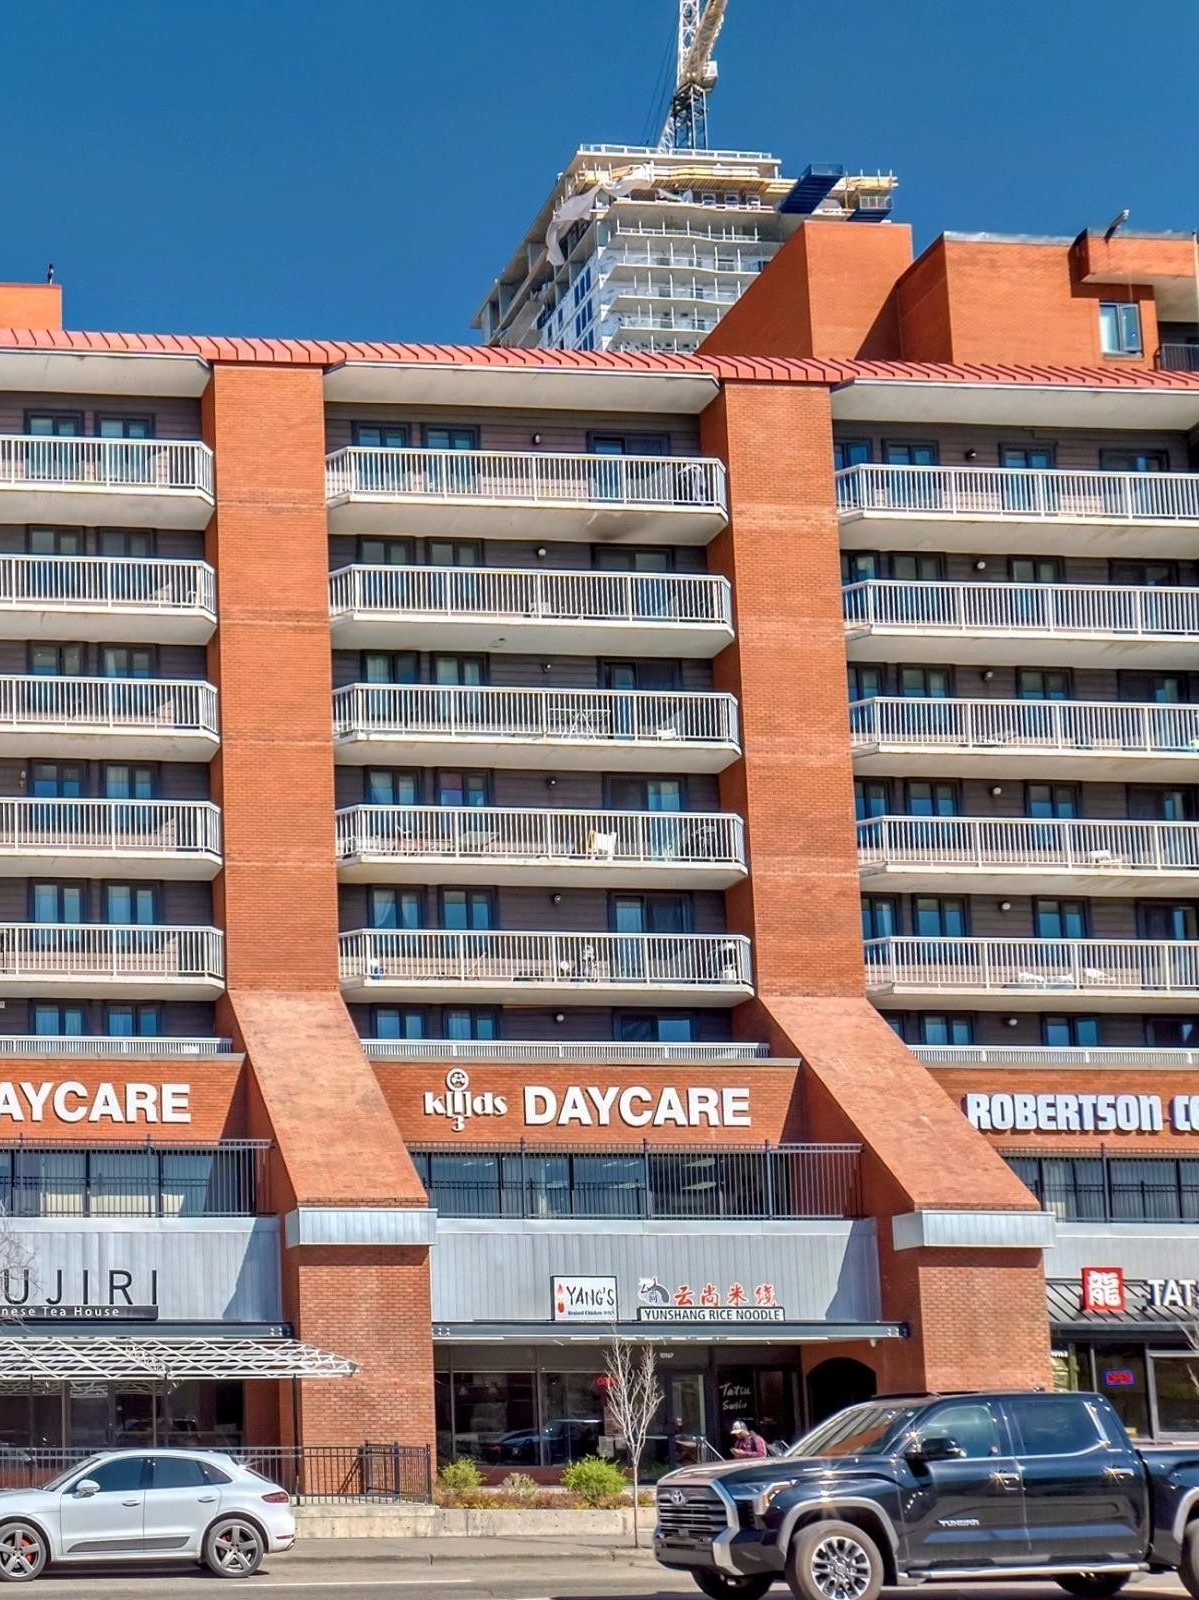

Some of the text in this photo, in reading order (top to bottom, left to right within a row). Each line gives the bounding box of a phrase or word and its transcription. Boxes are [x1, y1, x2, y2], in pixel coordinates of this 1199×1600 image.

[523, 1085, 752, 1127] DAYCARE
[966, 1093, 1163, 1131] ROBERTSON
[566, 1286, 615, 1306] YANG'S
[1147, 1279, 1199, 1307] TAT
[42, 1306, 67, 1317] Tea
[74, 1306, 120, 1317] House
[644, 1309, 780, 1320] YUNSHANG RICE NOODLE
